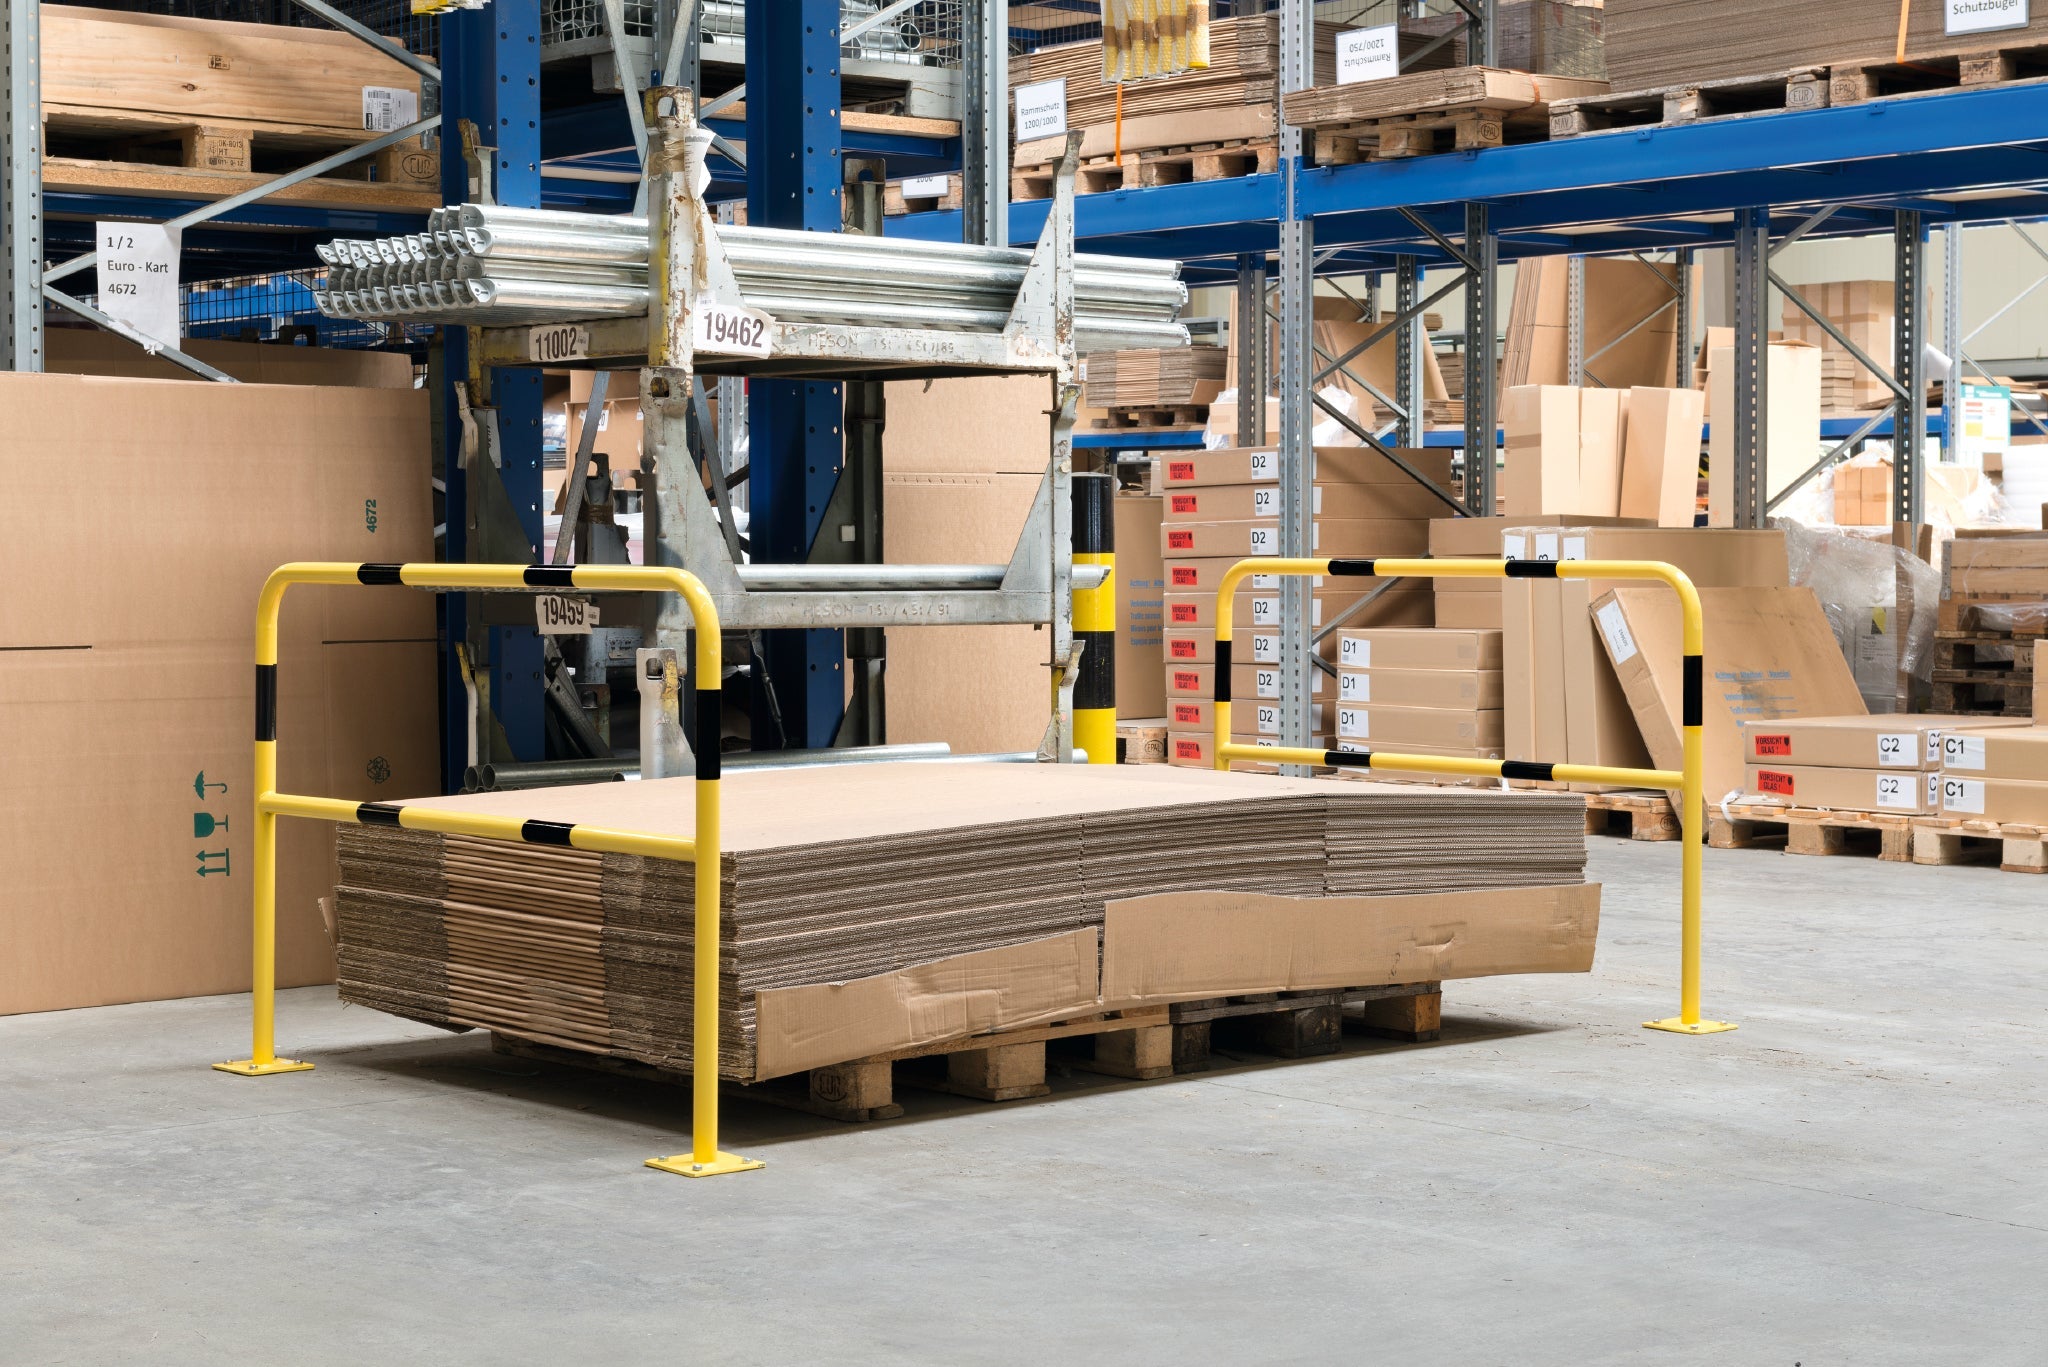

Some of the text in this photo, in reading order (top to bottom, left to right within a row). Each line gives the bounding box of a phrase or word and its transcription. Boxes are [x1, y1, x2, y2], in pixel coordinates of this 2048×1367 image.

[1349, 38, 1385, 53] 1200/750
[1344, 52, 1391, 67] Rammschutz
[1020, 102, 1060, 117] Rammschutz
[1024, 115, 1058, 129] 1200/1000
[218, 148, 228, 156] HT
[107, 235, 134, 250] 1 / 2
[107, 260, 135, 272] Euro
[145, 261, 168, 273] Kart
[107, 283, 137, 295] 4672
[704, 311, 764, 348] 19462
[535, 327, 577, 361] 11002
[1252, 456, 1266, 469] D2
[1256, 492, 1269, 505] D2
[365, 498, 378, 534] 4672
[1252, 532, 1266, 544] D2
[543, 596, 584, 625] 19459
[1254, 602, 1268, 614] D2
[1255, 638, 1268, 651] D2
[1343, 639, 1356, 654] D1
[1258, 673, 1272, 686] D2
[1342, 676, 1355, 690] D1
[1259, 709, 1273, 723] D2
[1341, 711, 1354, 725] D1
[1755, 736, 1782, 745] VORSICHT
[1880, 737, 1900, 753] C2
[1945, 738, 1965, 754] C1
[1761, 745, 1775, 754] GLAS
[1759, 772, 1786, 783] VORSICHT
[1763, 782, 1777, 791] GLAS
[1879, 778, 1899, 794] C2
[1945, 781, 1964, 798] C1
